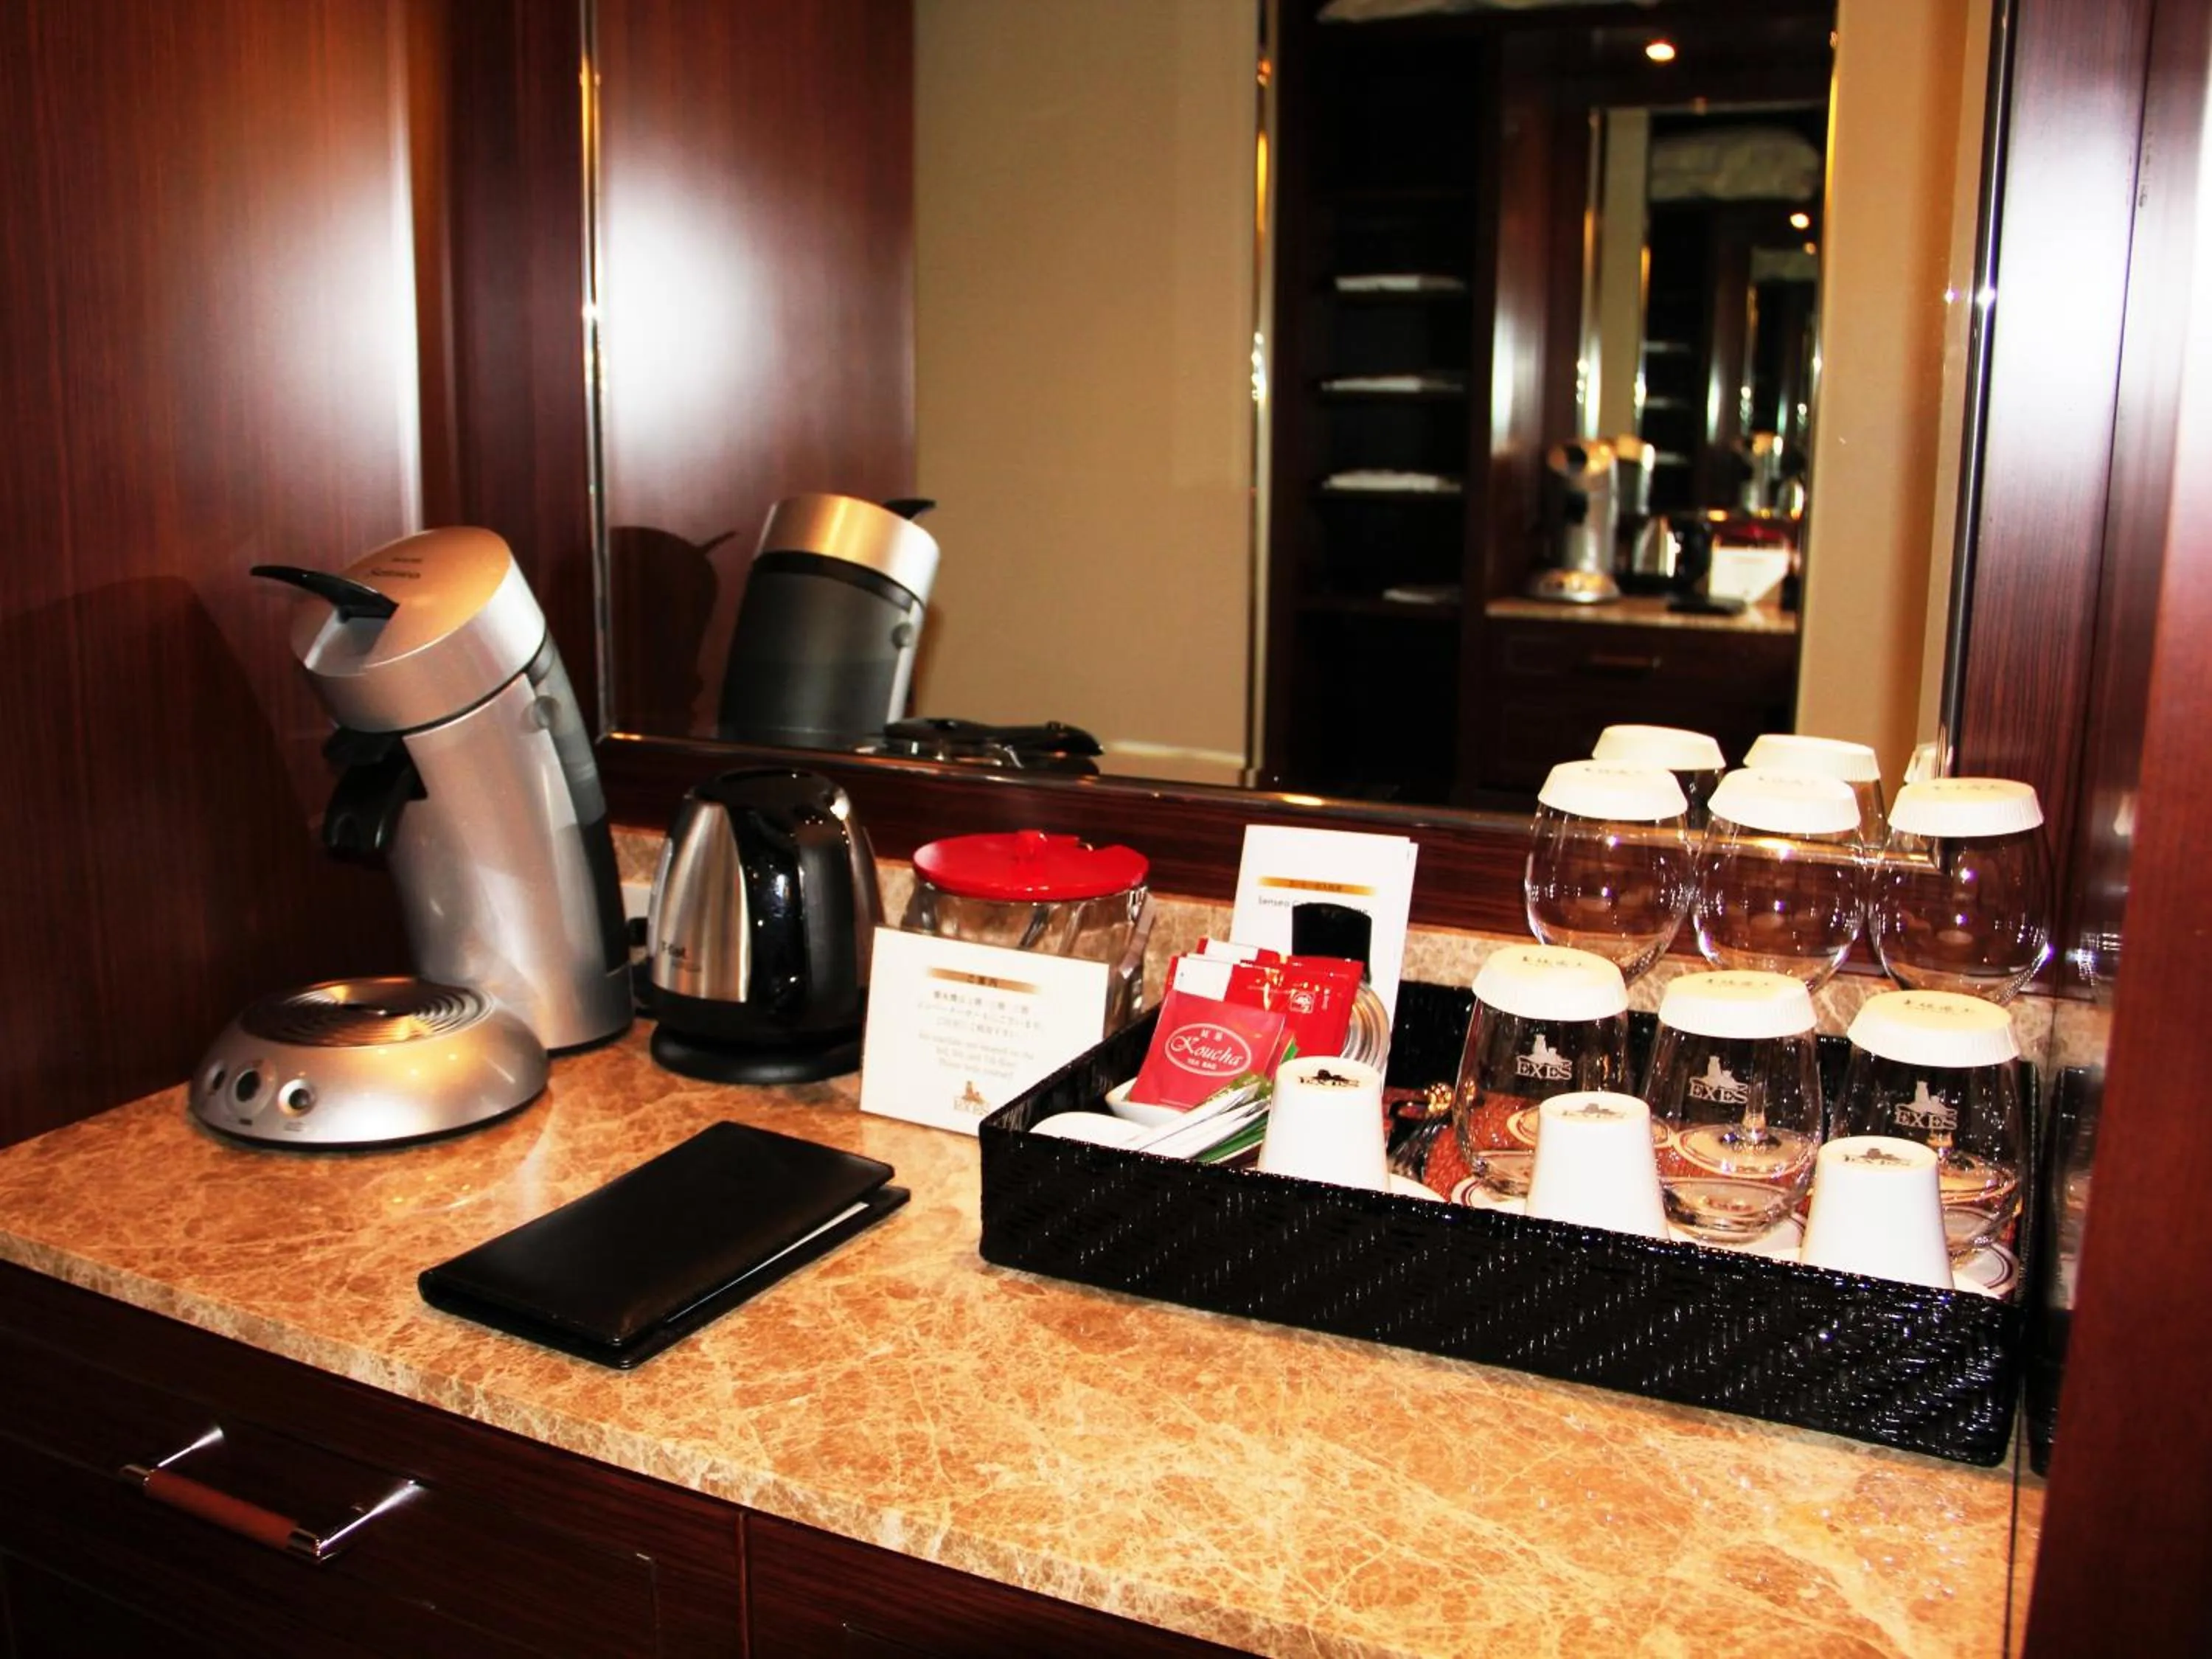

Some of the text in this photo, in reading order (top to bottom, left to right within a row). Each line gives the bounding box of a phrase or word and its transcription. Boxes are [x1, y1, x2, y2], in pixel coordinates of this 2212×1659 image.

[1516, 1057, 1573, 1080] EXES
[1688, 1079, 1748, 1104] EXES
[1894, 1105, 1958, 1130] EXES
